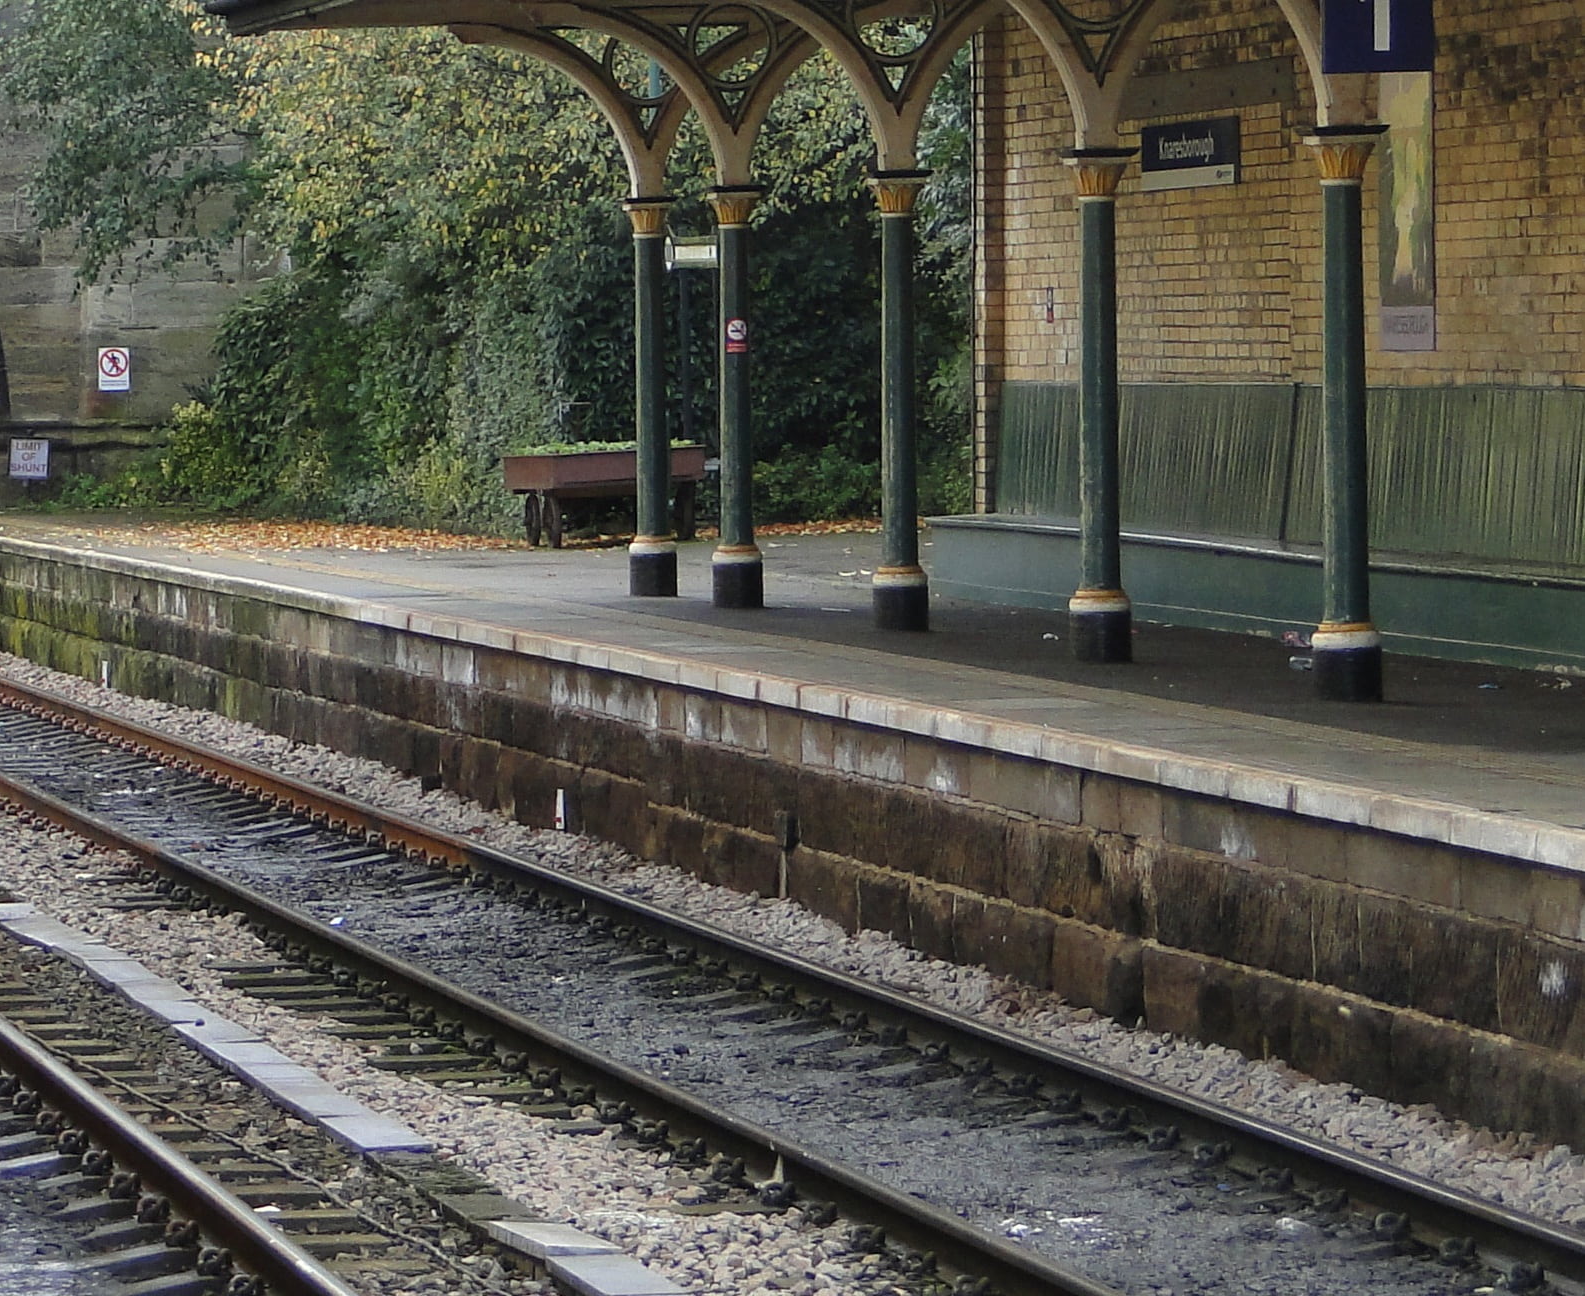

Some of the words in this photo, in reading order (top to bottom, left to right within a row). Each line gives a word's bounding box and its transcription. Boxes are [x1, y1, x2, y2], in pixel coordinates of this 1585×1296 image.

[1158, 129, 1215, 162] Knaresborough
[16, 441, 43, 451] LIMIT
[21, 452, 37, 461] OF
[10, 463, 46, 473] SHUNT
